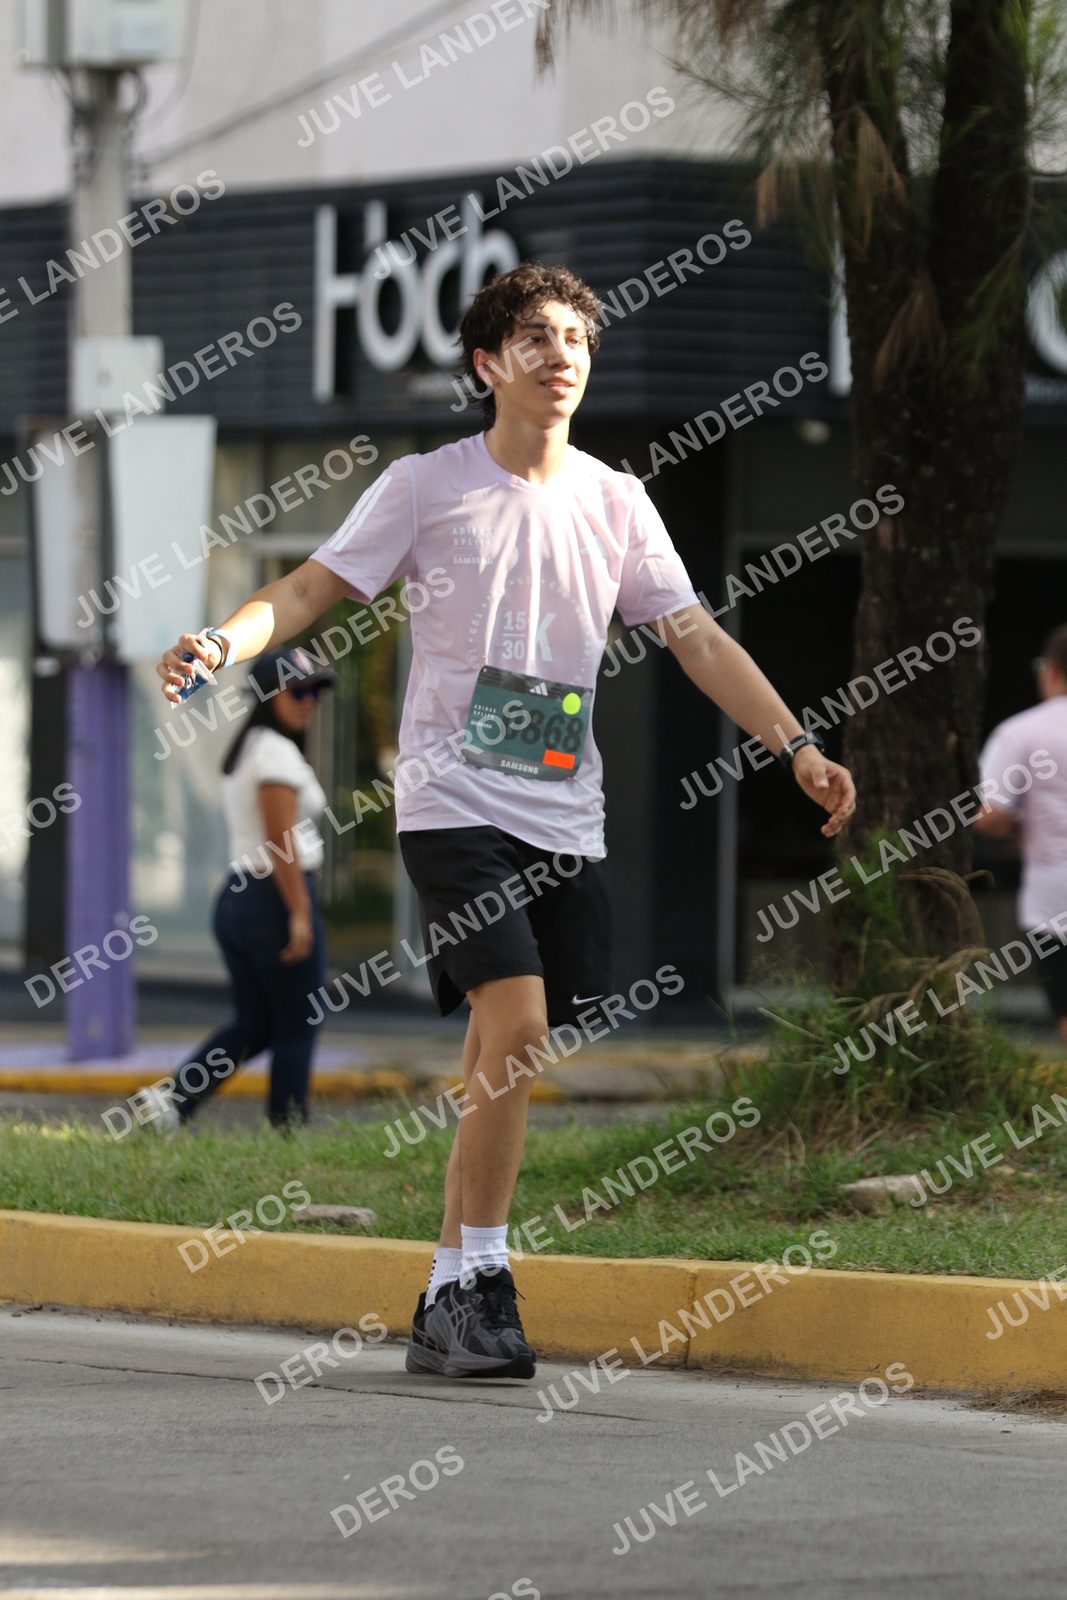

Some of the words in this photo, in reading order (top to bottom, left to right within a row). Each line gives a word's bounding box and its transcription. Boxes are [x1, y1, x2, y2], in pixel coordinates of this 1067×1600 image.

[452, 527, 491, 535] ADI
[452, 556, 494, 564] SAMSU
[503, 611, 527, 631] 15
[502, 640, 525, 661] 30
[500, 759, 540, 775] SAMSUNG
